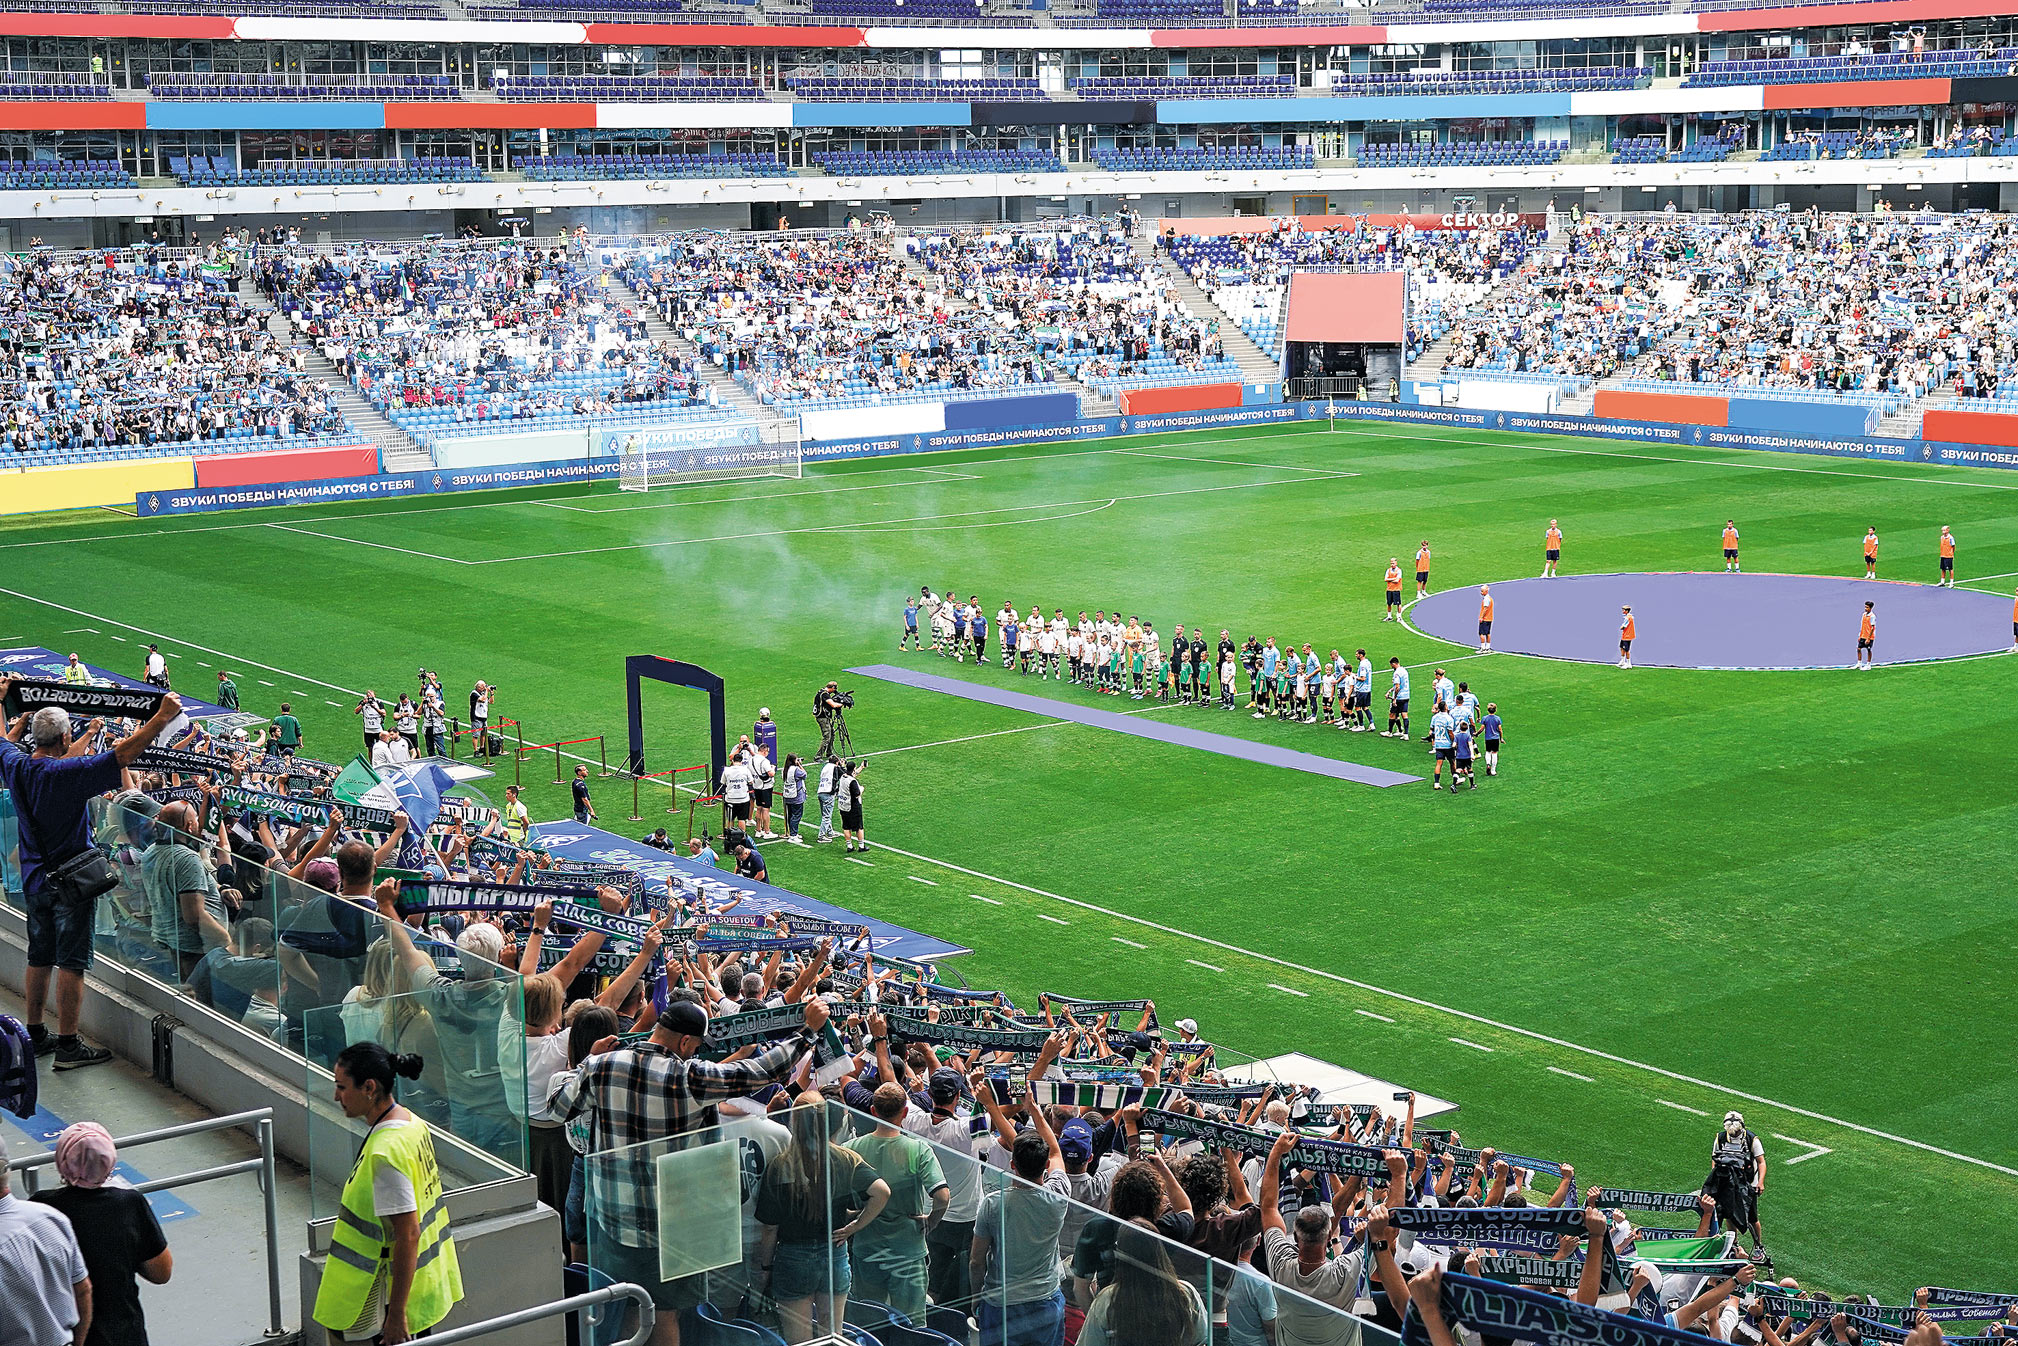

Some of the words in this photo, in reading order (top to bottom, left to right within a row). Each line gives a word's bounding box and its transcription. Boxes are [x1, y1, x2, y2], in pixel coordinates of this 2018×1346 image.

[1441, 213, 1518, 228] СЕКТОР
[1134, 418, 1165, 429] ЗВУКИ
[1166, 416, 1202, 427] ПОБЕДЫ
[1203, 411, 1264, 425] НАЧИНАЮТСЯ
[1265, 409, 1272, 418] С
[1272, 407, 1295, 417] ТЕБЯ!
[1324, 406, 1357, 415] ЗВУКИ
[1359, 408, 1394, 418] ПОБЕДЫ
[1395, 409, 1452, 421] НАЧИНАЮТСЯ
[1454, 413, 1460, 421] С
[1460, 414, 1484, 424] ТЕБЯ!
[929, 435, 962, 446] ЗВУКИ
[963, 432, 1004, 444] ПОБЕДЫ
[1005, 427, 1071, 441] НАЧИНАЮТСЯ
[1072, 426, 1079, 435] С
[1080, 424, 1106, 434] ТЕБЯ!
[1511, 418, 1539, 427] ЗВУКИ
[1541, 419, 1578, 431] ПОБЕДЫ
[1579, 423, 1644, 436] НАЧИНАЮТСЯ
[1645, 427, 1652, 436] С
[1653, 428, 1680, 439] ТЕБЯ!
[1709, 432, 1744, 443] ЗВУКИ
[1745, 434, 1788, 447] ПОБЕДЫ
[1790, 438, 1864, 453] НАЧИНАЮТСЯ
[1866, 443, 1874, 453] С
[1874, 444, 1905, 456] ТЕБЯ!
[704, 453, 740, 465] ЗВУКИ
[741, 451, 788, 462] ПОБЕДЫ
[789, 445, 861, 458] НАЧИНАЮТСЯ
[863, 443, 871, 452] С
[872, 441, 899, 452] ТЕБЯ!
[1941, 448, 1979, 460] ЗВУКИ
[1981, 451, 2018, 464] ПОБЕД
[452, 474, 492, 485] ЗВУКИ
[494, 470, 545, 483] ПОБЕДЫ
[546, 462, 627, 478] НАЧИНАЮТСЯ
[629, 460, 638, 470] С
[638, 459, 670, 470] ТЕБЯ!
[171, 495, 217, 507] ЗВУКИ
[218, 491, 275, 505] ПОБЕДЫ
[277, 482, 367, 500] НАЧИНАЮТСЯ
[369, 482, 379, 491] С
[380, 479, 415, 491] ТЕБЯ!
[1437, 726, 1446, 737] 22
[221, 788, 259, 806] RYLIA
[260, 797, 321, 819] SOVETOV
[357, 807, 393, 824] СОВЕ
[350, 821, 370, 829] 1942
[428, 884, 472, 907] МЫ
[553, 903, 602, 926] ЫЛЬЯ
[605, 917, 647, 938] СОВЕ
[718, 915, 757, 925] SOVETOV
[792, 922, 825, 932] КРЫЛЬЯ
[828, 924, 865, 934] СОВЕТО
[709, 928, 736, 937] ЫЛЬЯ
[737, 930, 776, 940] СОВЕТО
[732, 1004, 806, 1034] СОВЕТО
[831, 1005, 860, 1017] ЫЛЬЯ
[877, 1006, 928, 1018] СОВЕТО
[943, 1040, 984, 1049] САМАРА
[1143, 1112, 1218, 1138] КРЫЛЬЯ
[1222, 1130, 1273, 1153] СОВЕ
[1198, 1136, 1253, 1153] САМАРА
[1282, 1148, 1326, 1169] ЫЛЬЯ
[1340, 1154, 1388, 1172] СОВЕ
[1352, 1150, 1373, 1158] КЛУБ
[1337, 1167, 1356, 1175] 1942
[1357, 1169, 1376, 1177] ГОДУ
[1601, 1191, 1662, 1206] КРЫЛЬЯ
[1664, 1194, 1700, 1208] СОВЕ
[1401, 1210, 1469, 1225] ЫЛЬЯ
[1484, 1209, 1585, 1225] СОВЕТО
[1435, 1222, 1527, 1230] САМАРА
[1475, 1229, 1560, 1250] РЫЛЬЯ
[1481, 1257, 1494, 1274] К
[1496, 1257, 1566, 1278] КРЫЛЬЯ
[1564, 1278, 1580, 1288] 194
[1937, 1290, 1996, 1306] КРЫЛЬЯ
[1451, 1283, 1560, 1334] YLIA
[1771, 1299, 1837, 1315] КРЫЛЬЯ
[1926, 1310, 1957, 1319] рылья
